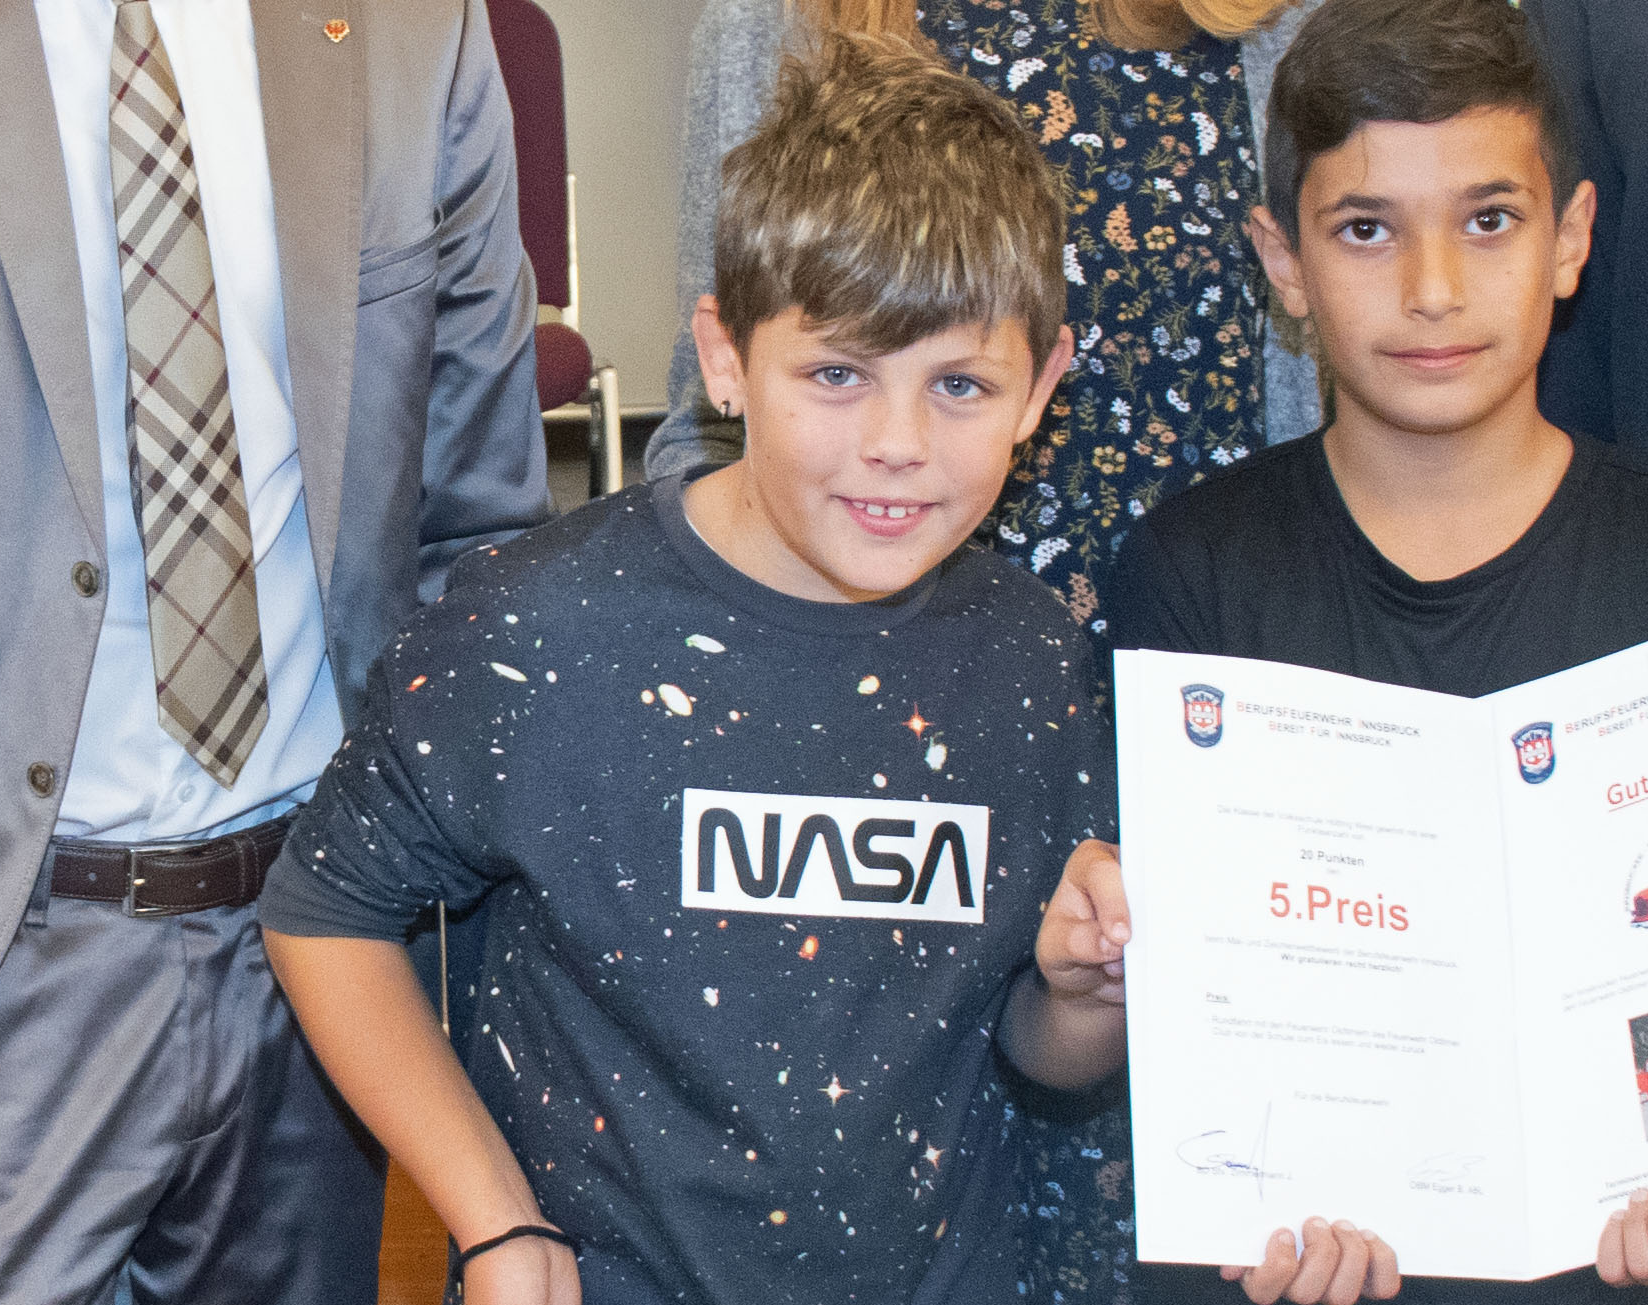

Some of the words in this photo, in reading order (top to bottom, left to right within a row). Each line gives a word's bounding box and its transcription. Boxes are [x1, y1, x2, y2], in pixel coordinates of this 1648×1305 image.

[1235, 700, 1352, 726] BERUFSFEUERWEHR
[1357, 717, 1422, 737] INNSBRUCK
[1268, 719, 1305, 734] BEREIT
[1335, 729, 1393, 747] INNSBRUCK
[697, 807, 975, 908] NASA
[1317, 849, 1365, 867] Punkten
[1269, 881, 1409, 932] 5.Preis
